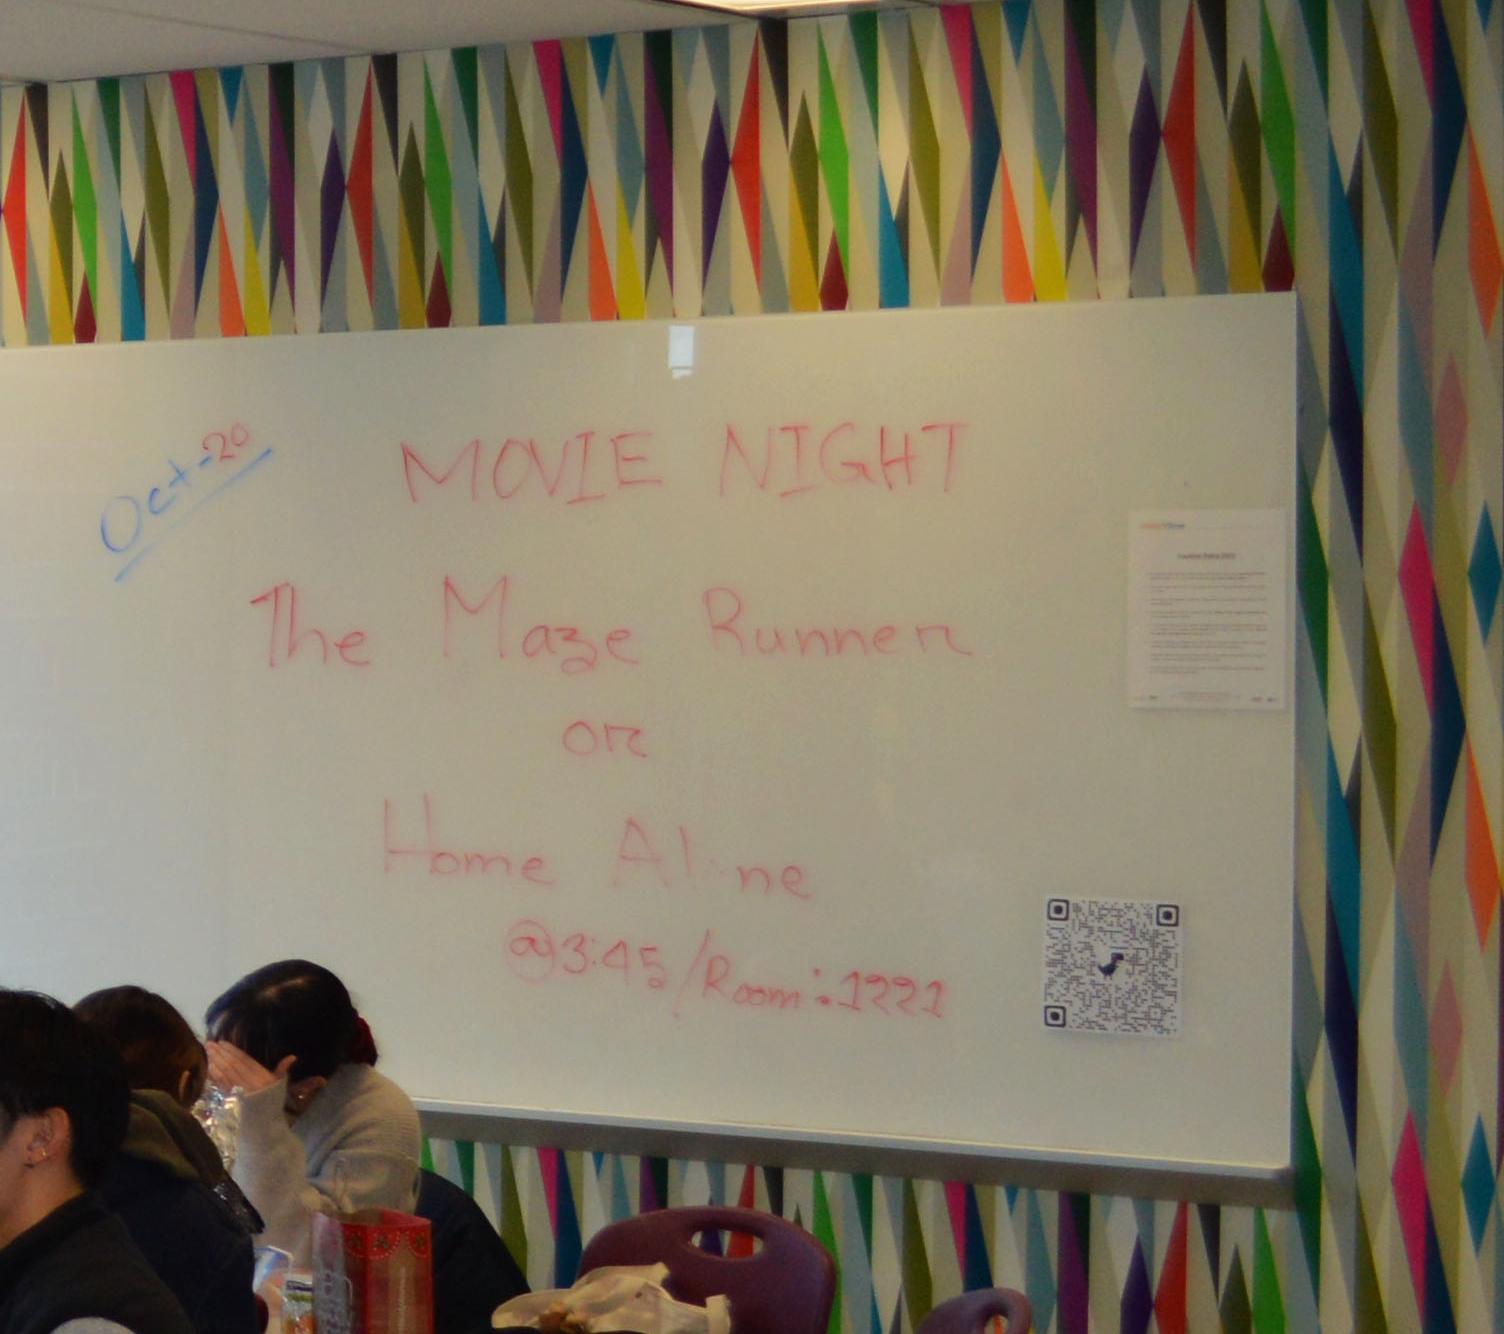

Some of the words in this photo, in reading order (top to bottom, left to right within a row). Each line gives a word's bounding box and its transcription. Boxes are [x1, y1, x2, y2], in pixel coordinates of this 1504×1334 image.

[400, 430, 663, 505] MOVIE
[719, 422, 968, 498] NIGHT
[249, 581, 371, 668] The
[442, 574, 639, 675] Maze
[702, 586, 974, 657] Runner
[384, 791, 555, 885] Home
[612, 818, 811, 899] Alne
